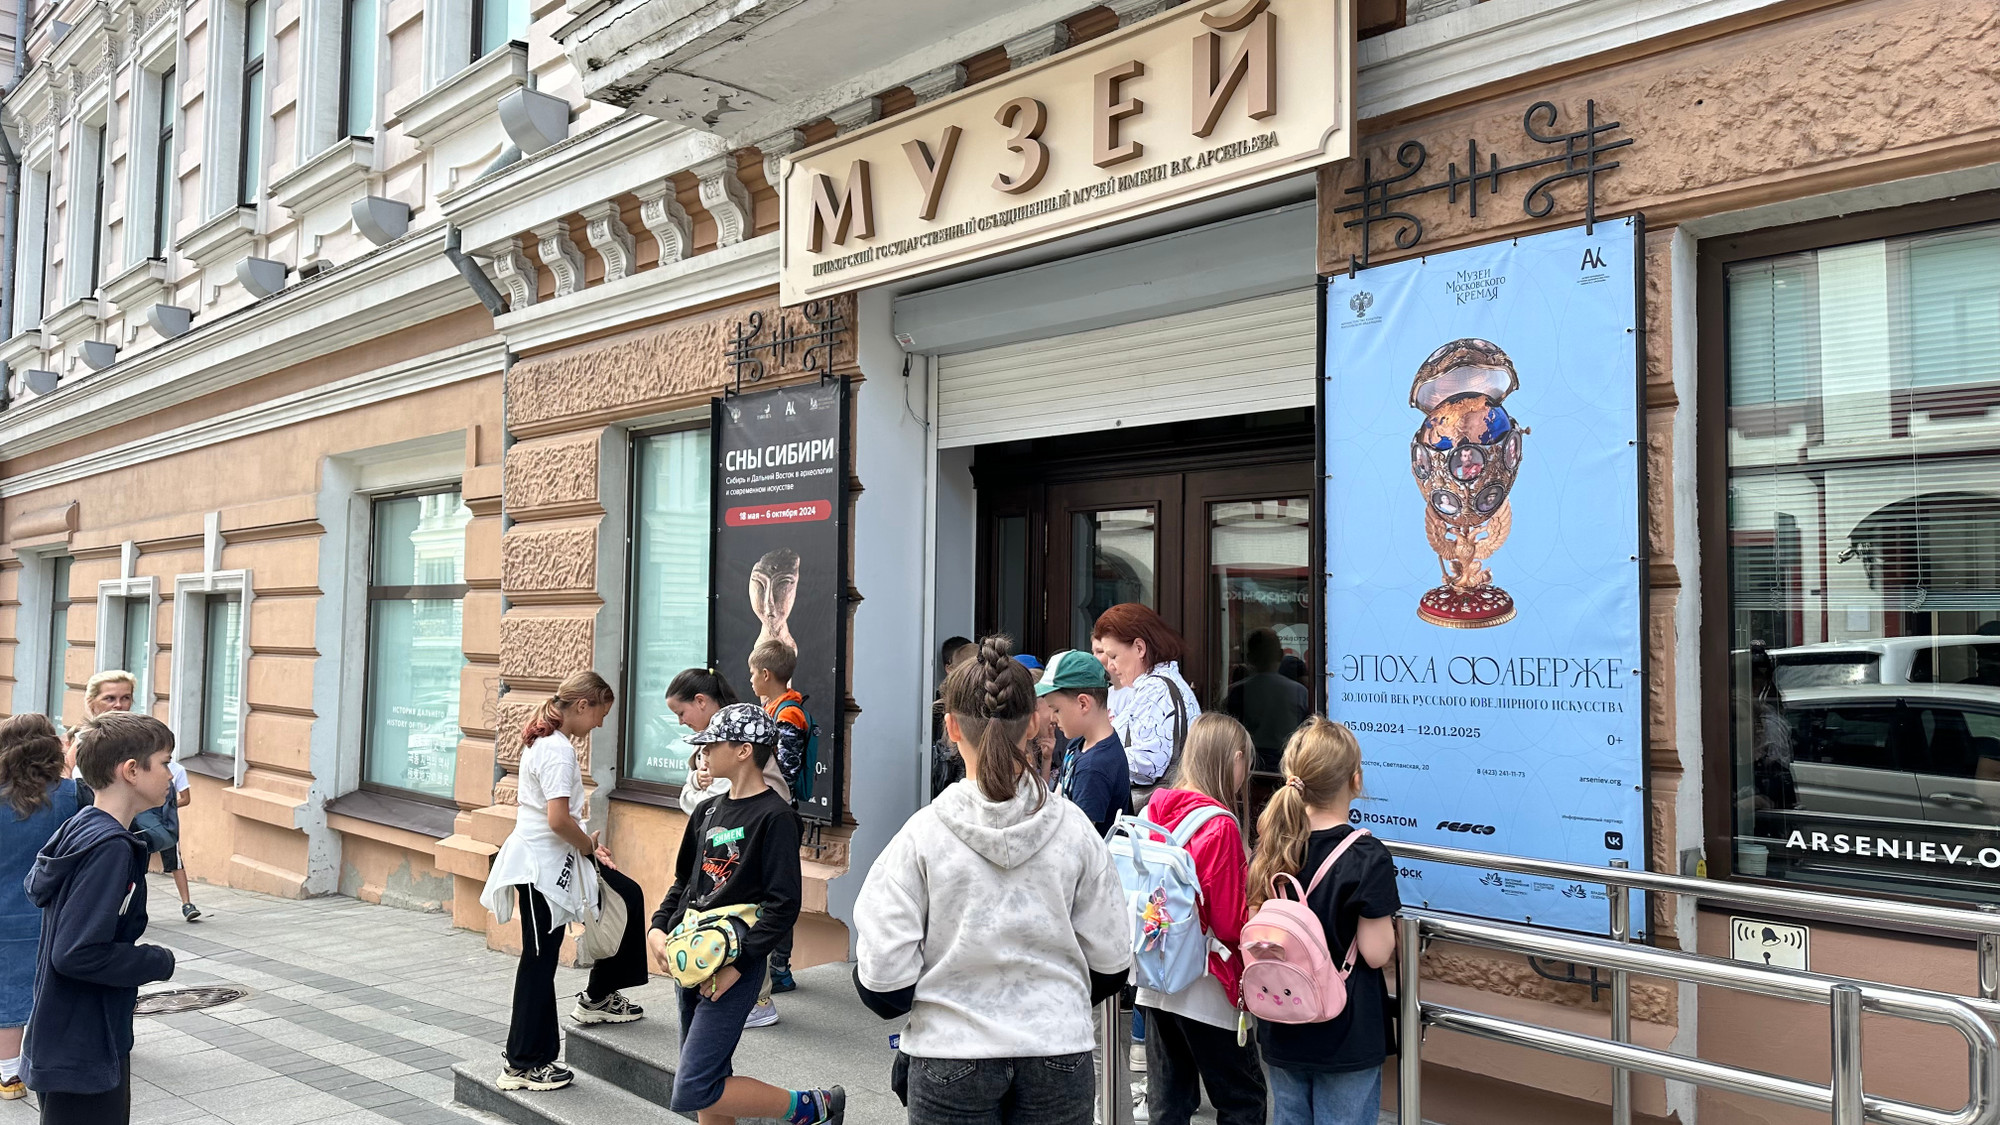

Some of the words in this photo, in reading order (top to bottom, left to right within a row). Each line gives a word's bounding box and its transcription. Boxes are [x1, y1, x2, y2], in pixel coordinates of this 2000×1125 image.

[806, 0, 1278, 254] МУЗЕЙ
[813, 246, 874, 276] ПРИМОРСКИЙ
[875, 217, 977, 260] ГОСУДАРСТВЕННЫЙ
[977, 189, 1071, 231] ОБЪЕДИНЕННЫЙ
[1073, 176, 1115, 206] МУЗЕЙ
[1118, 163, 1167, 191] ИМЕНИ
[1196, 131, 1280, 169] АРСЕНЬЕВА
[725, 447, 761, 472] СНЫ
[765, 437, 834, 468] СИБИРИ
[725, 476, 746, 485] Сибирь
[751, 473, 775, 484] Дальний
[775, 471, 795, 480] Восток
[800, 467, 833, 479] археологии
[729, 485, 766, 497] современном
[766, 483, 795, 494] искусстве
[739, 512, 747, 520] 18
[747, 512, 760, 520] мая
[766, 510, 771, 519] 6
[771, 508, 798, 520] октября
[798, 506, 816, 516] 2024
[1341, 654, 1437, 684] ЭПОХА
[1447, 655, 1624, 690] ФАБЕРЖЕ
[1341, 691, 1388, 704] ЗОЛОТОЙ
[1391, 694, 1410, 705] ВЕК
[1412, 694, 1467, 707] РУССКОГО
[1470, 696, 1549, 710] ЮВЕЛИРНОГО
[1552, 699, 1624, 713] ИСКУССТВА
[386, 718, 408, 728] HISTORY
[408, 721, 415, 729] OF
[1344, 720, 1405, 734] 05.09.2024
[1606, 734, 1624, 746] 0+
[815, 761, 828, 775] 0+
[1482, 768, 1498, 777] (423)
[1498, 769, 1526, 778] 241-11-73
[1579, 776, 1622, 787] arseniev.org
[1364, 813, 1418, 828] ROSATOM
[1435, 820, 1496, 836] FESCO
